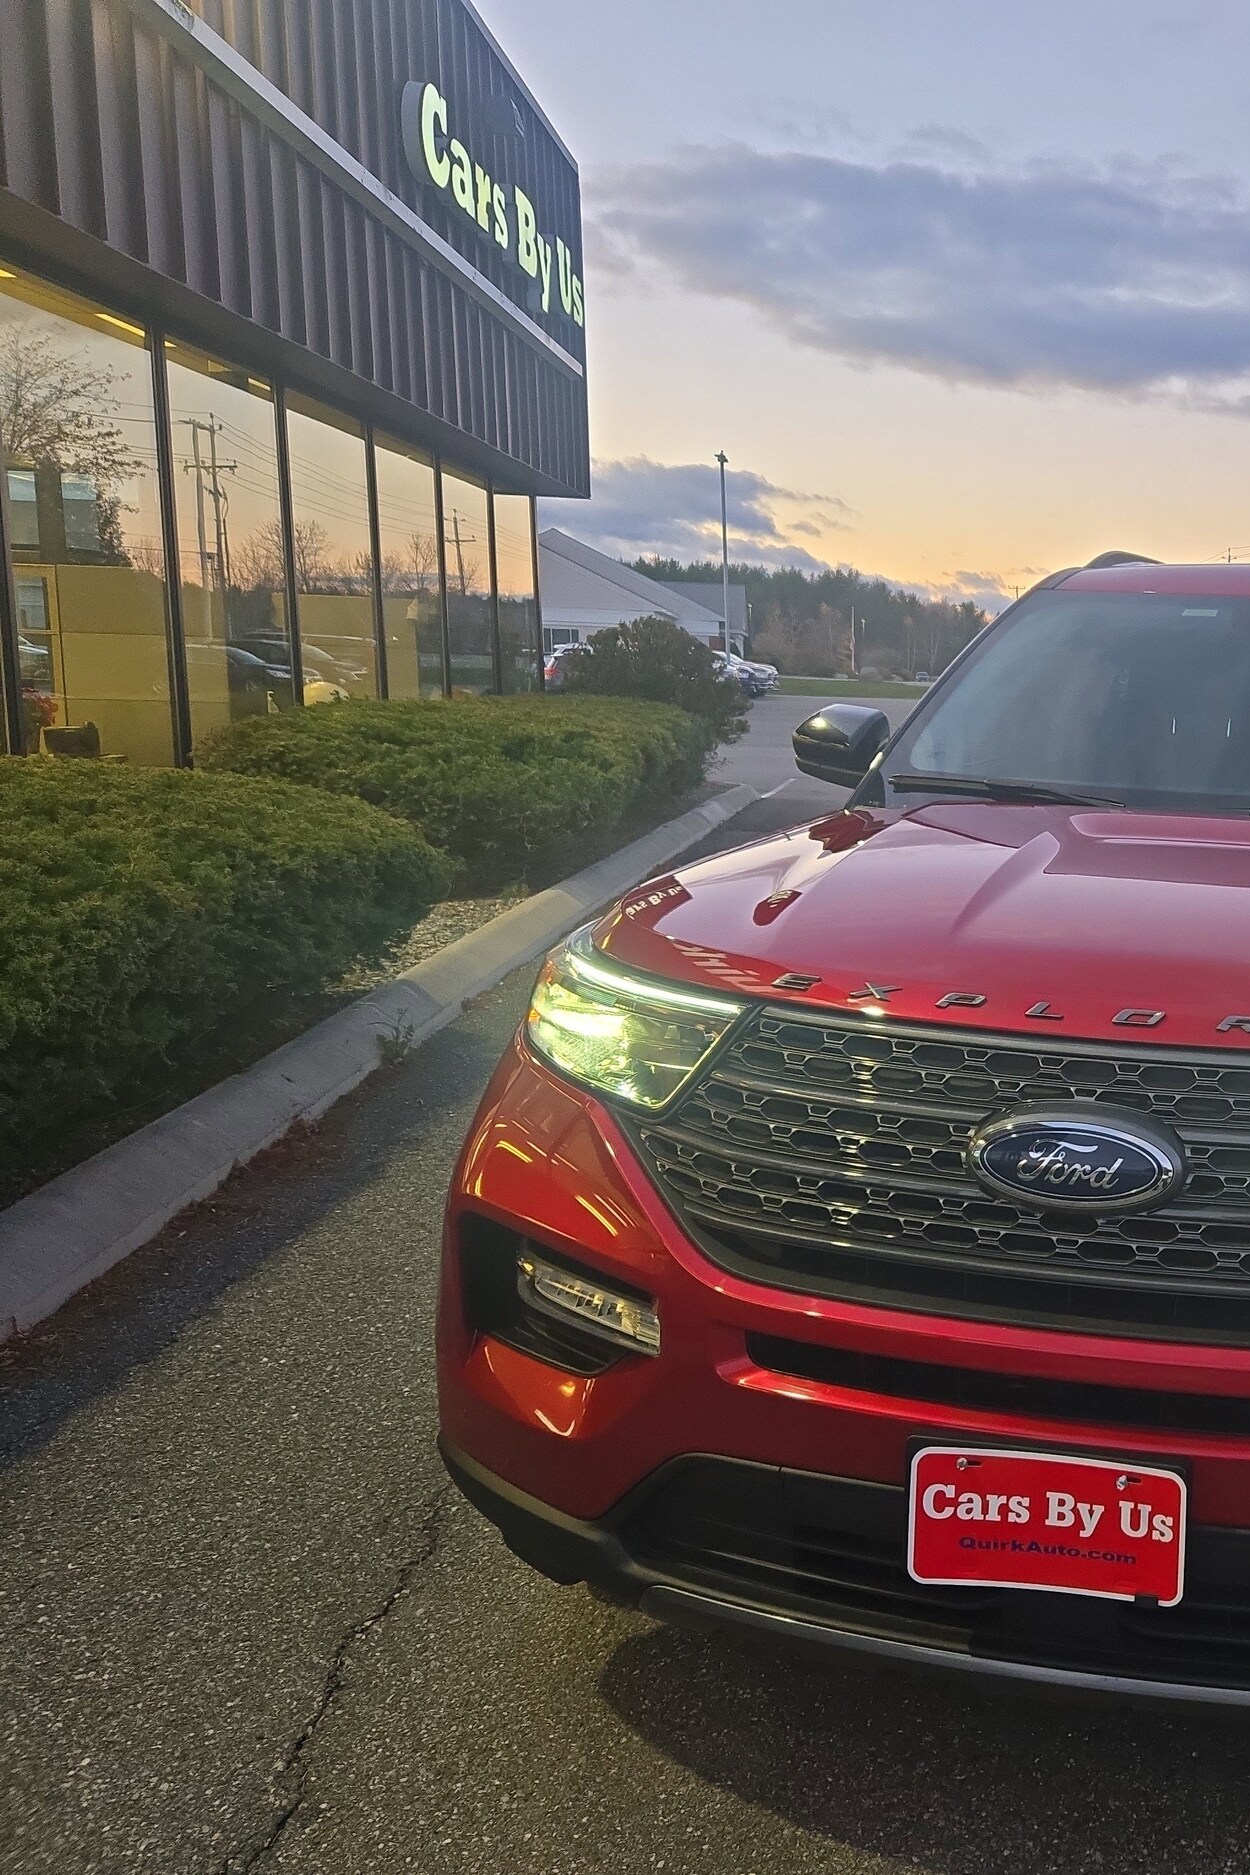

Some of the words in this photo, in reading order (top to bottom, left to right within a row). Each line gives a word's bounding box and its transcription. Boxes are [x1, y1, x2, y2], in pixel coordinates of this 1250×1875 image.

[421, 82, 509, 250] Cars
[514, 184, 552, 314] By
[556, 234, 584, 328] Us
[1016, 1139, 1124, 1190] Ford
[922, 1483, 1031, 1525] Cars
[1044, 1491, 1105, 1538] By
[1118, 1500, 1175, 1544] Us
[958, 1536, 1138, 1566] QuirkAuto.com
